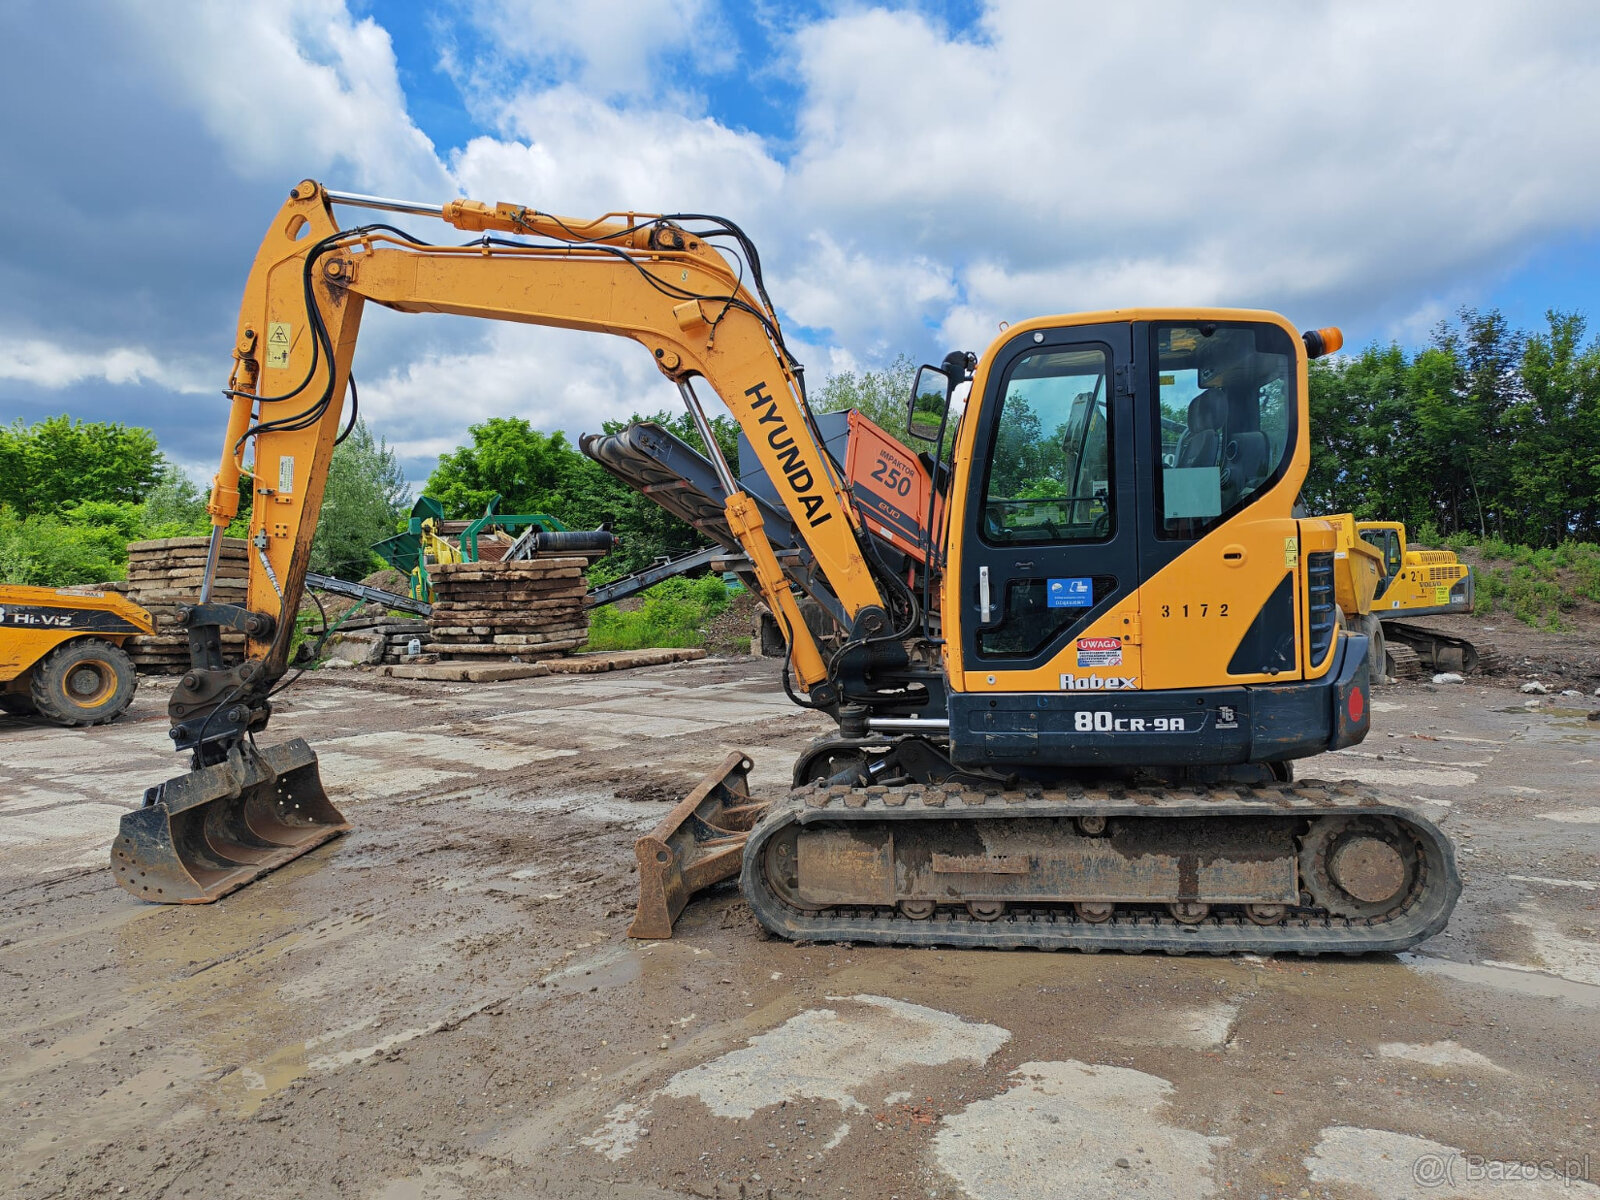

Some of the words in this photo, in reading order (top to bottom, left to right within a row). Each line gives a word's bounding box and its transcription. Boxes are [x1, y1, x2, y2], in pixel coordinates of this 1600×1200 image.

[744, 381, 833, 528] HYUNDAI
[880, 449, 915, 478] IMPAKTOR
[870, 459, 911, 497] 250
[1080, 640, 1117, 649] UWAGA
[1059, 673, 1138, 690] Robex
[1074, 711, 1185, 732] 80CR-9A
